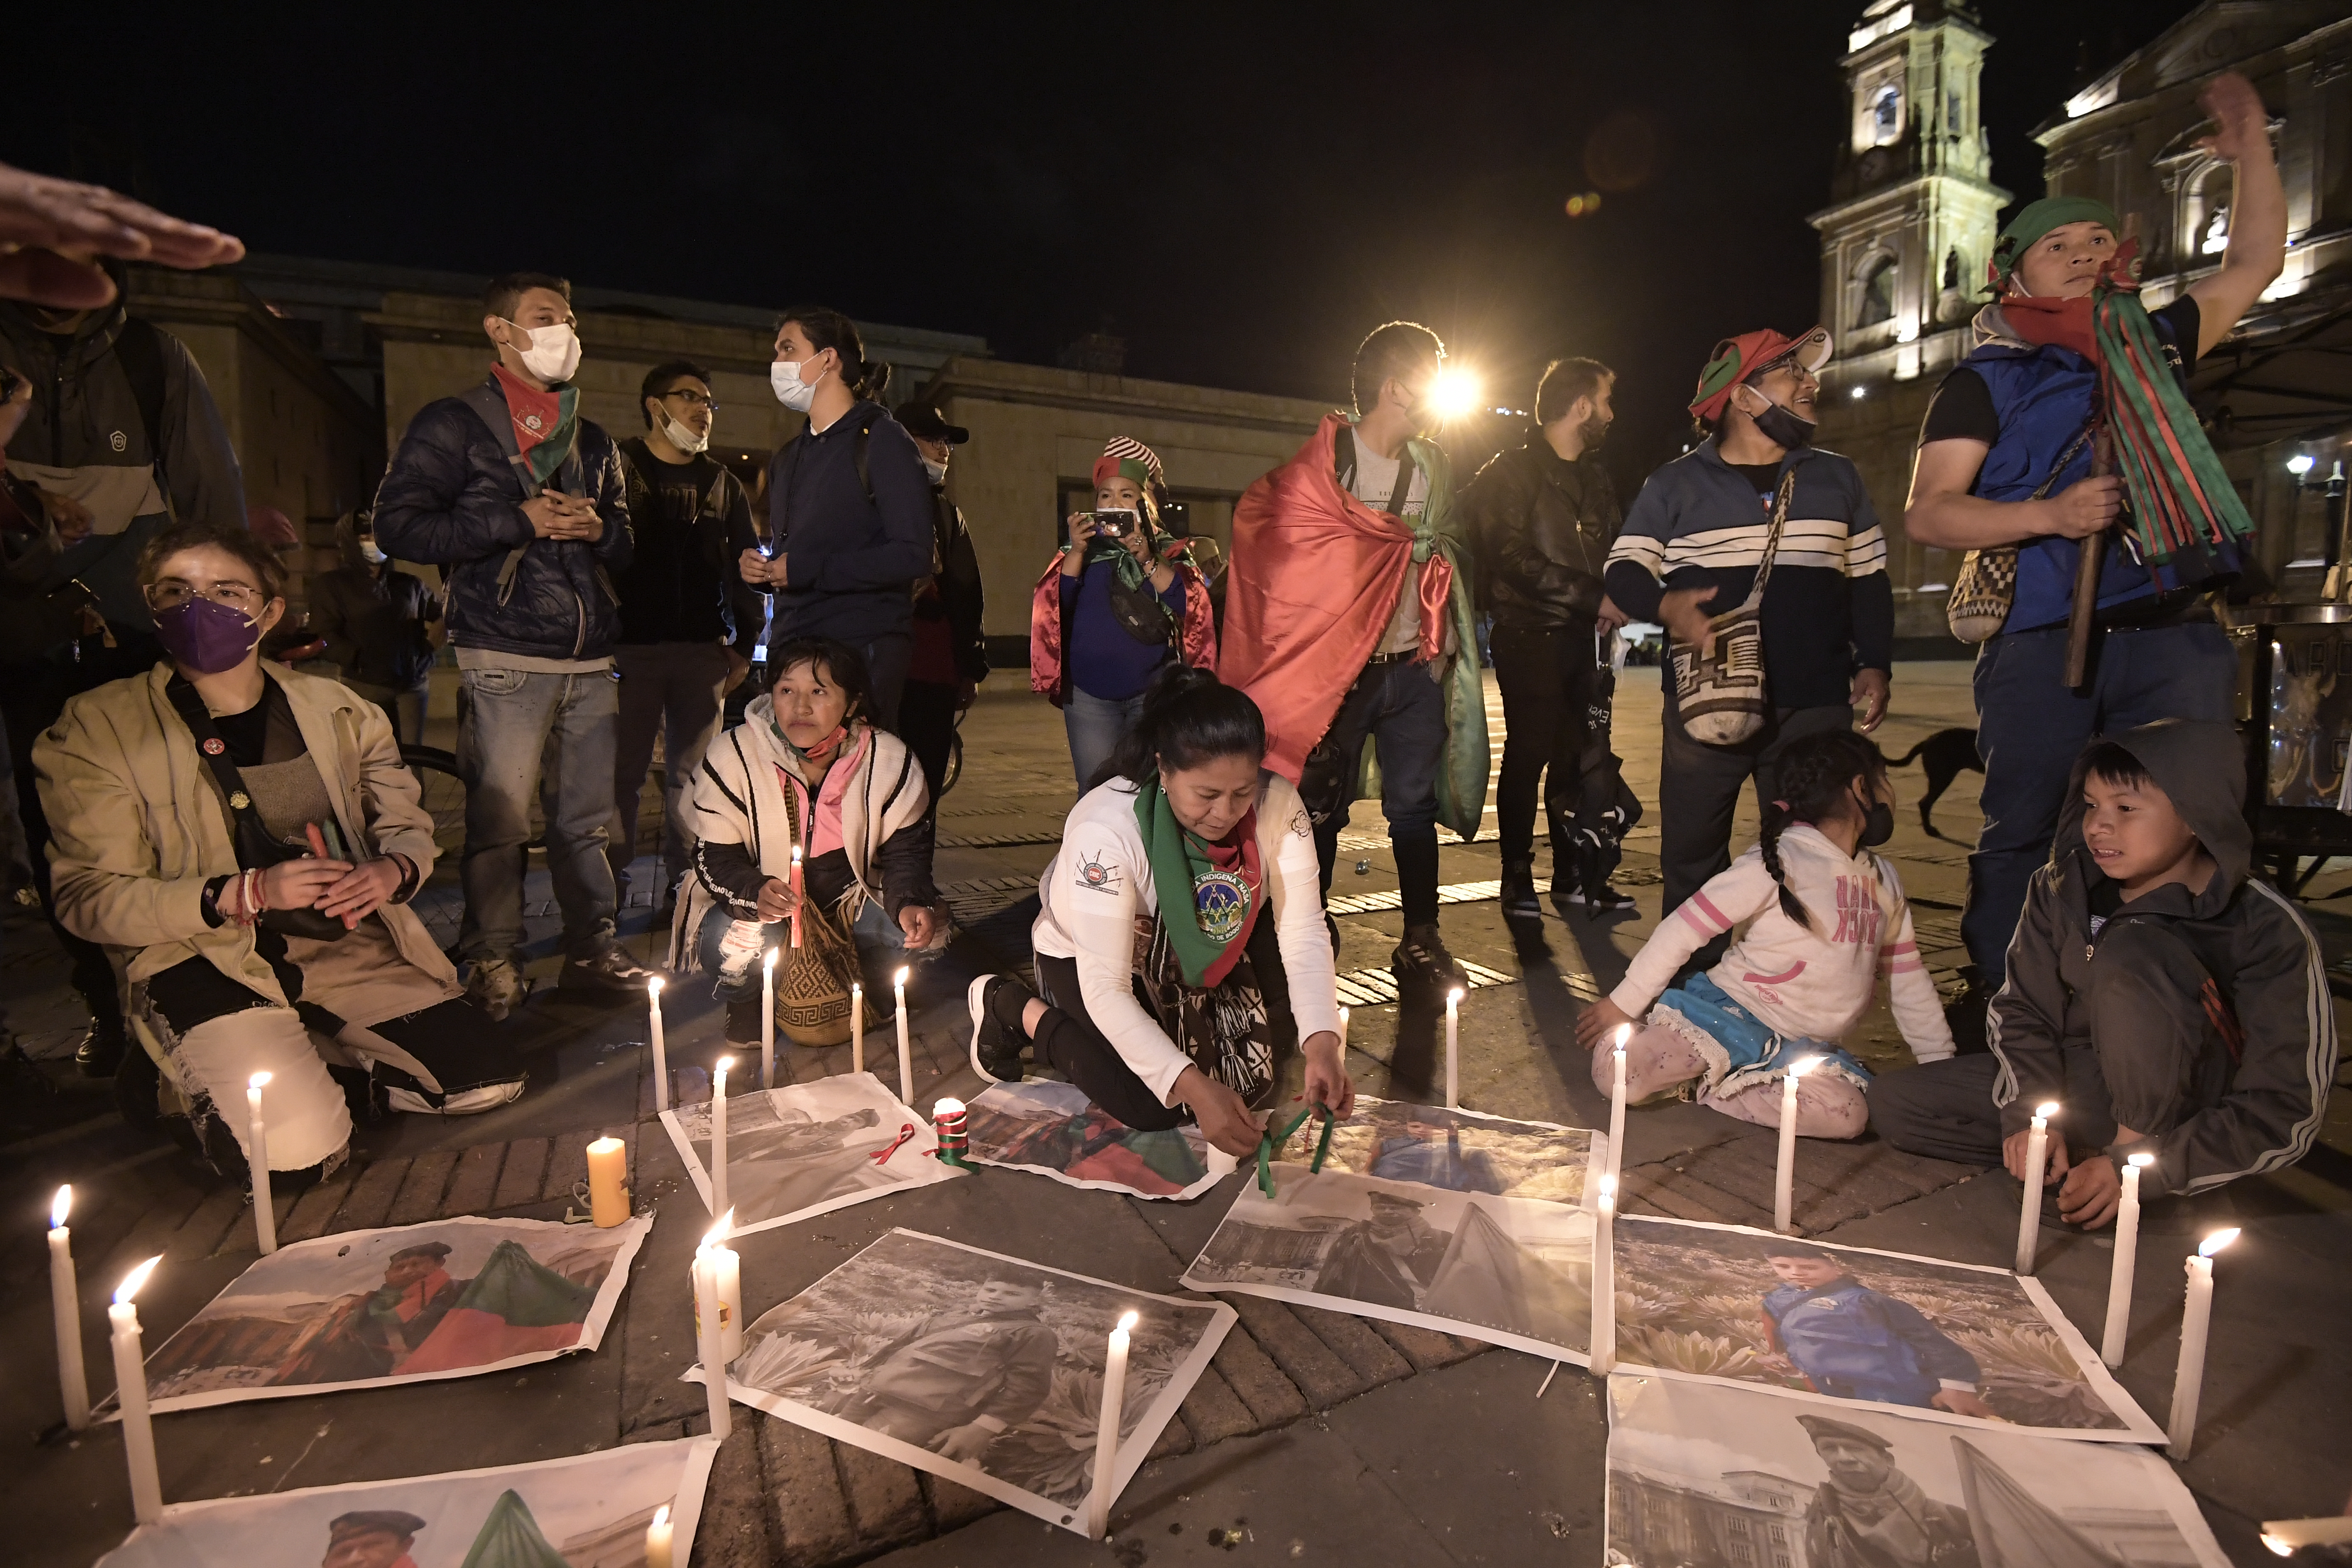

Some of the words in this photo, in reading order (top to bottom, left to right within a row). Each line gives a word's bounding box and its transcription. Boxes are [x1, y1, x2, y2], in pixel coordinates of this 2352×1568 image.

[1089, 871, 1100, 879] CRIC
[1201, 873, 1236, 885] INDIGENA
[1238, 883, 1249, 904] NASA
[1482, 1320, 1539, 1338] Delgado
